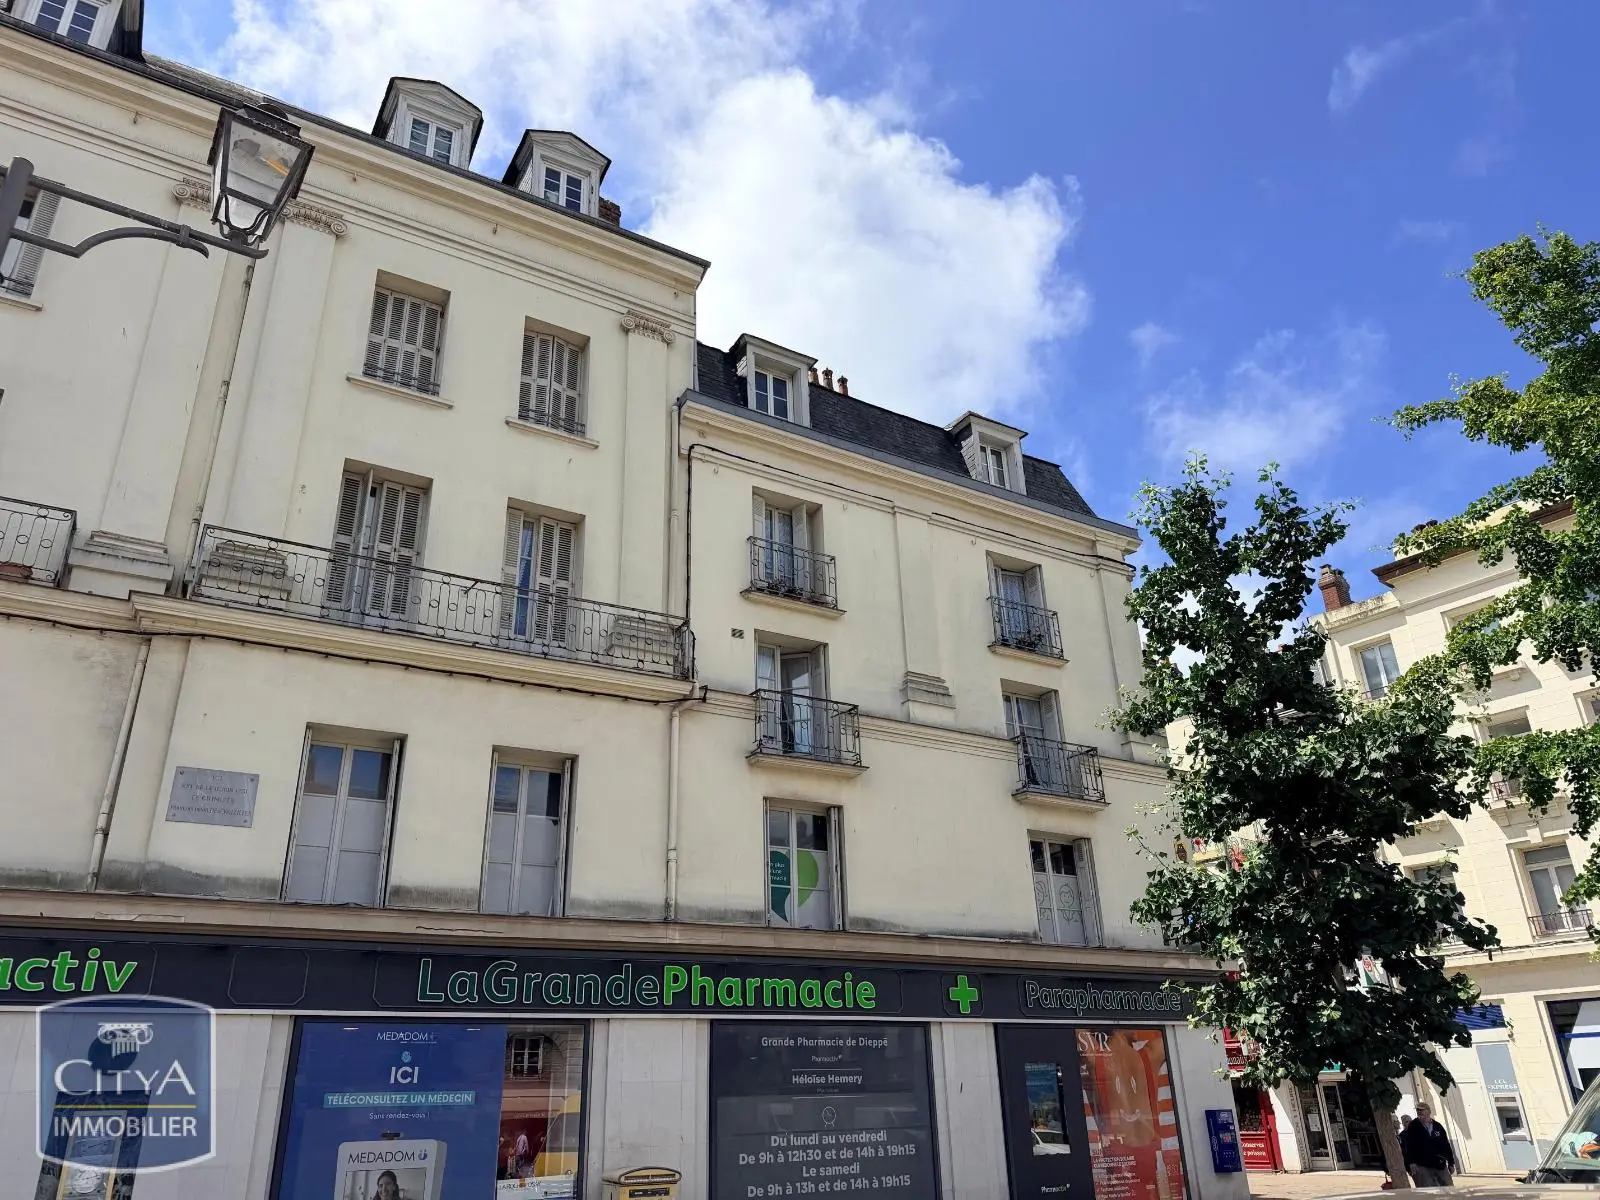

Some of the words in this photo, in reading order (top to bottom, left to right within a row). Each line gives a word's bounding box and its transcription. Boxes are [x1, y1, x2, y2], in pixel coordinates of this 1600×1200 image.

[1025, 980, 1181, 1016] Parapharmacie
[376, 1031, 429, 1041] MEDADOM
[761, 1037, 795, 1047] Grande
[797, 1037, 844, 1047] Pharmacie
[846, 1037, 857, 1046] de
[859, 1037, 888, 1048] Dieppe
[1078, 1031, 1112, 1052] SVR
[389, 1066, 419, 1084] ICI
[792, 1074, 826, 1084] Héloïse
[828, 1074, 863, 1084] Hemery
[327, 1093, 408, 1105] TÉLÉCONSULTEZ
[410, 1094, 426, 1103] UN
[428, 1092, 472, 1103] MÉDECIN
[369, 1112, 385, 1120] Sans
[770, 1136, 787, 1147] Du
[790, 1134, 819, 1145] lundi
[822, 1135, 836, 1144] au
[838, 1130, 887, 1143] vendredi
[348, 1151, 415, 1164] MEDADOM
[739, 1153, 756, 1165] De
[759, 1152, 774, 1163] 9h
[777, 1151, 784, 1162] à
[787, 1149, 822, 1162] 12h30
[825, 1150, 836, 1160] et
[839, 1147, 853, 1159] de
[856, 1146, 875, 1158] 14h
[877, 1145, 884, 1157] à
[887, 1144, 916, 1156] 19h15
[802, 1166, 817, 1177] Le
[819, 1162, 860, 1176] samedi
[747, 1186, 764, 1198] De
[768, 1184, 783, 1196] 9h
[786, 1183, 793, 1195] à
[795, 1181, 816, 1194] 13h
[818, 1181, 830, 1192] et
[833, 1178, 848, 1191] de
[850, 1177, 869, 1189] 14h
[872, 1176, 879, 1188] à
[881, 1174, 911, 1187] 19h15
